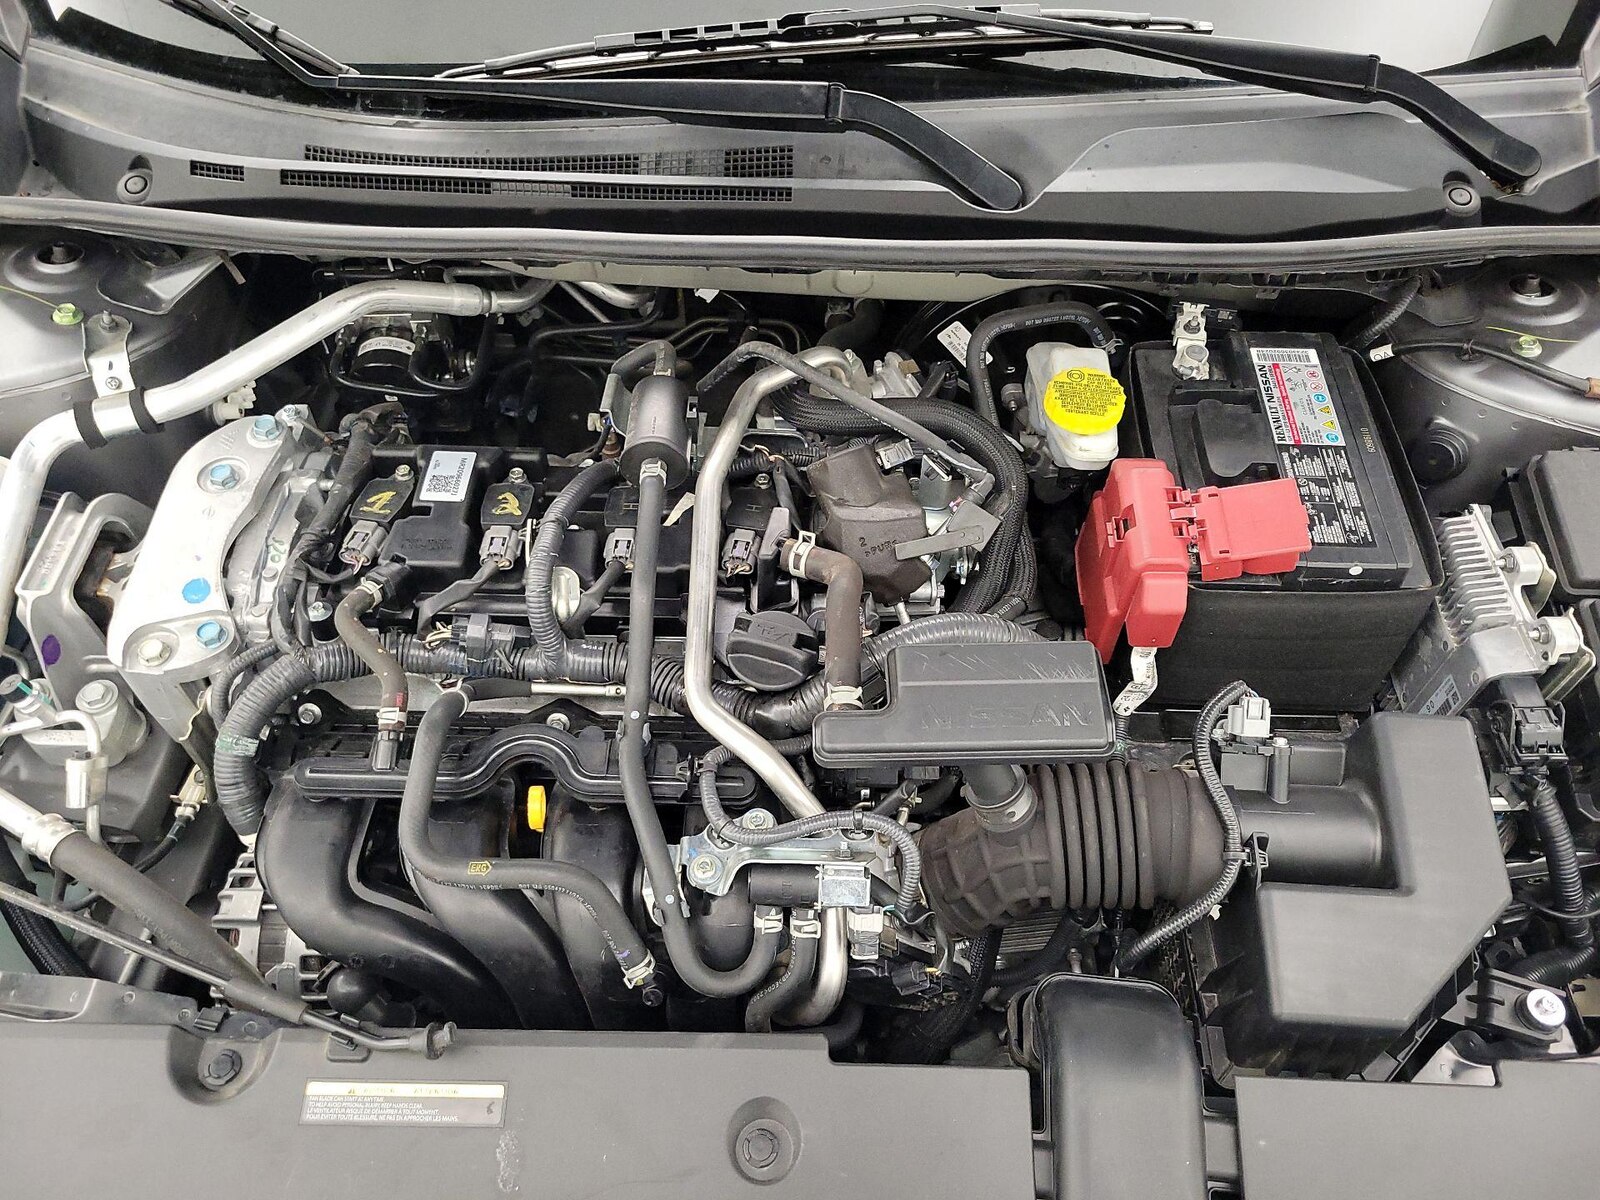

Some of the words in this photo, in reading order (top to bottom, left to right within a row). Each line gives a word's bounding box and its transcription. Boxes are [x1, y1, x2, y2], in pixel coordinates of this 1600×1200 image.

[1257, 364, 1276, 403] NISSAN
[1268, 406, 1287, 442] RENAULT
[359, 491, 397, 515] 1
[491, 492, 523, 516] 2
